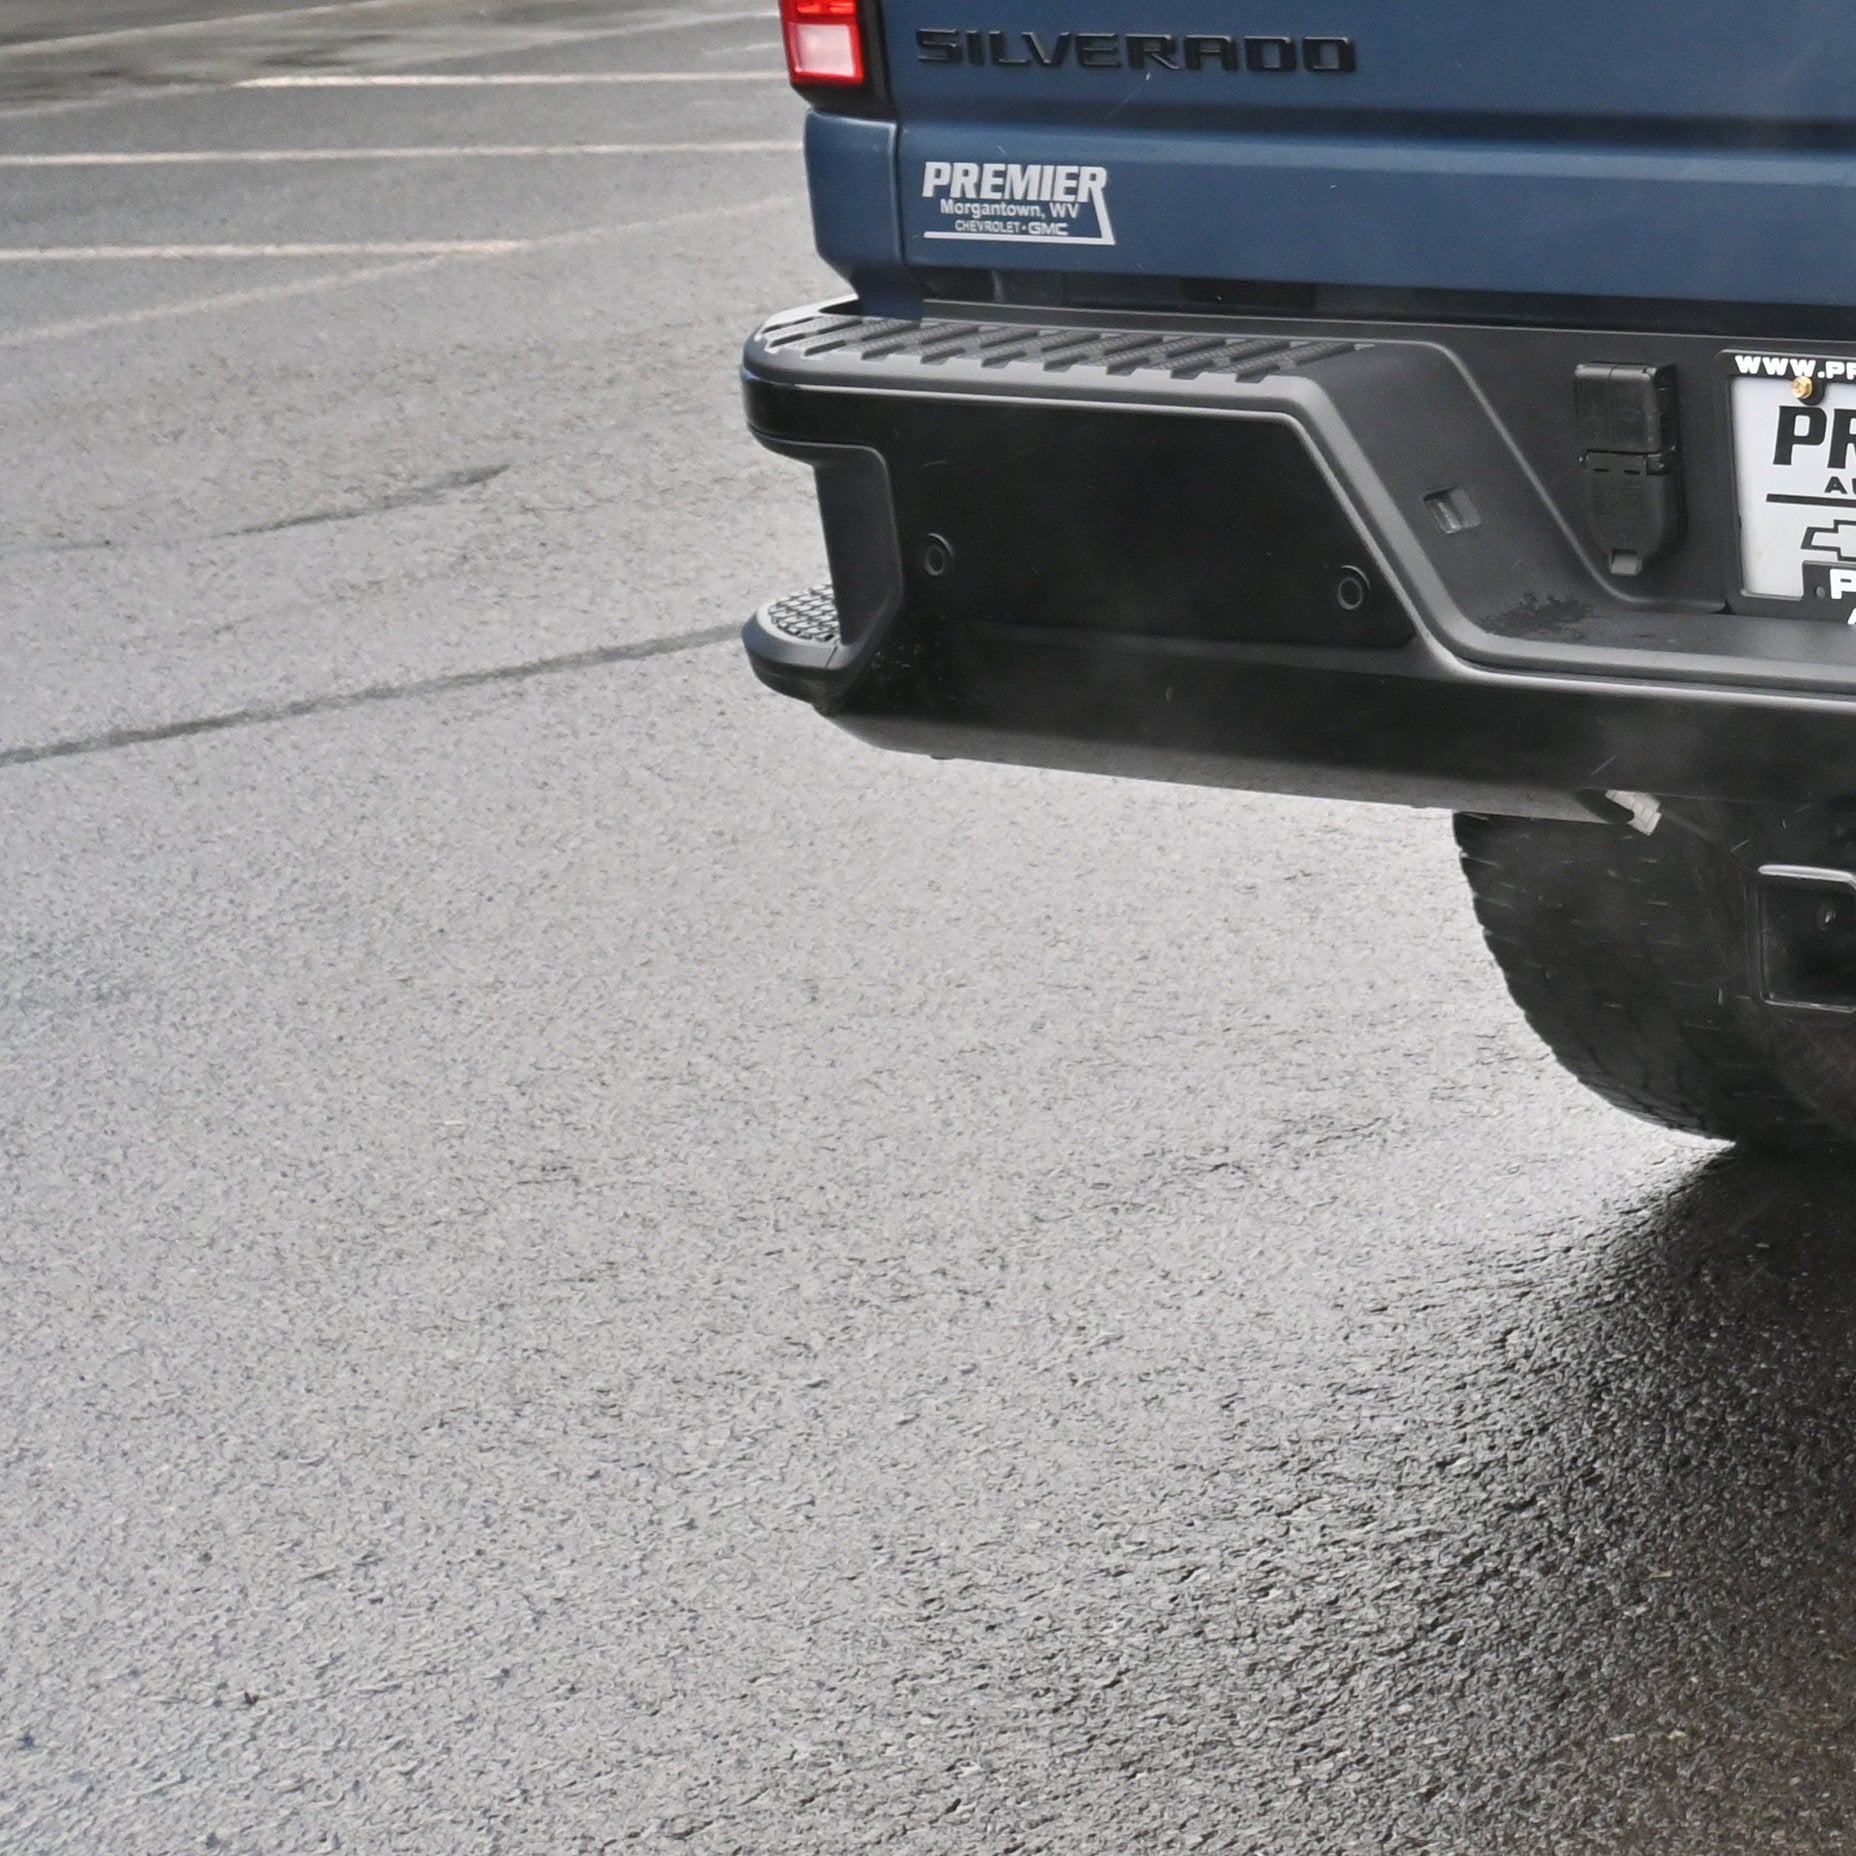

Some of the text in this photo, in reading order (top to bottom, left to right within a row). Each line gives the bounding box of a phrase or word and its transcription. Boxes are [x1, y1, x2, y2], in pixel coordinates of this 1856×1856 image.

[916, 27, 1357, 73] SILVERADO
[922, 161, 1108, 204] PREMIER
[940, 199, 1081, 219] Morgantown, WV
